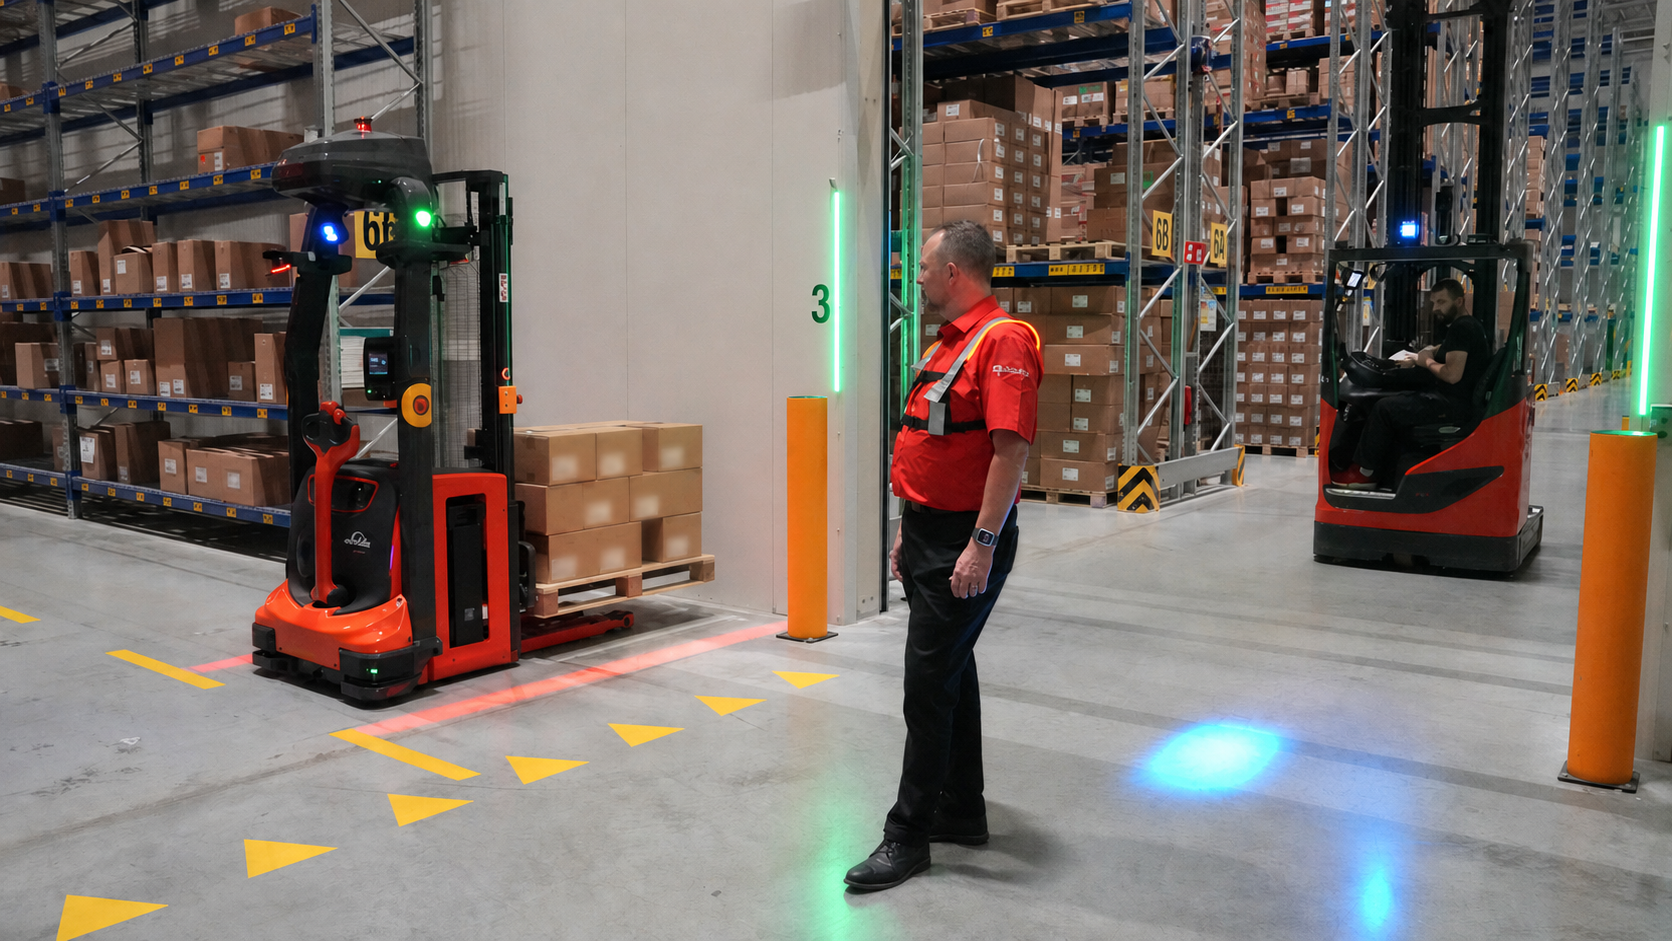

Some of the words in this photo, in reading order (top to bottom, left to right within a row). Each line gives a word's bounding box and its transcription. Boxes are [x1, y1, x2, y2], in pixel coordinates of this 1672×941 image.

[1156, 218, 1168, 251] 6B
[1214, 229, 1224, 260] 6A
[811, 283, 830, 324] 3
